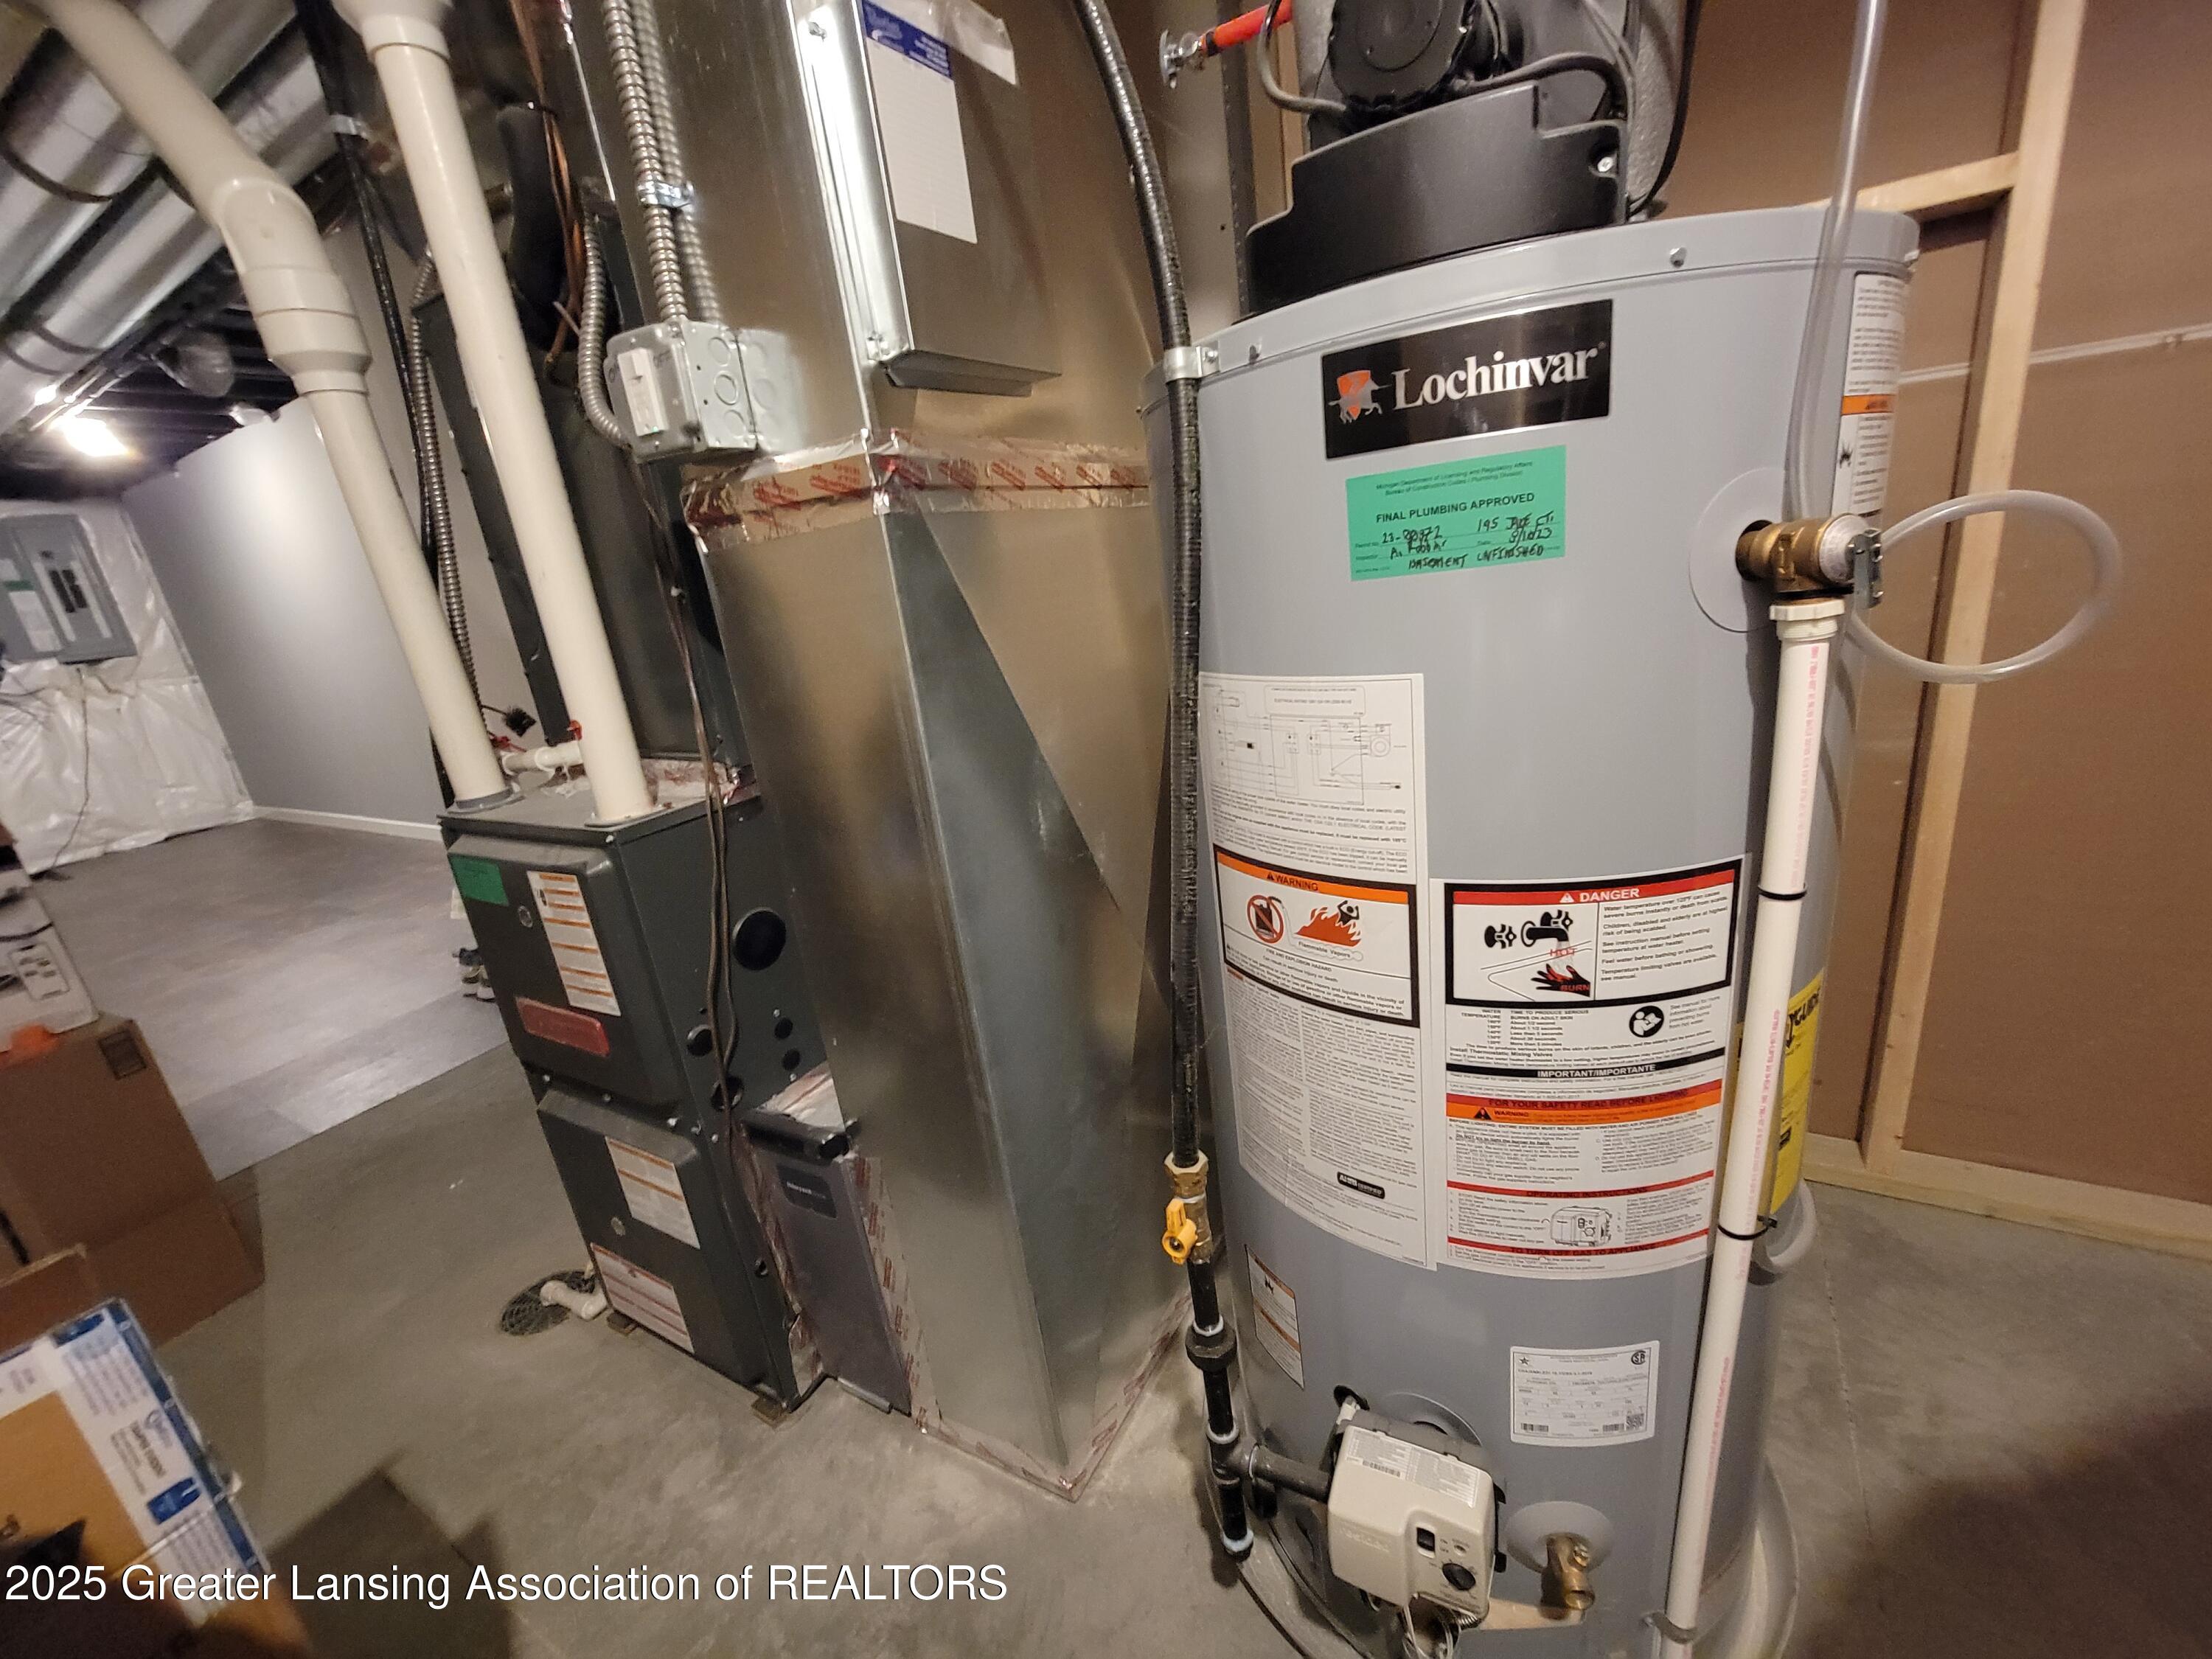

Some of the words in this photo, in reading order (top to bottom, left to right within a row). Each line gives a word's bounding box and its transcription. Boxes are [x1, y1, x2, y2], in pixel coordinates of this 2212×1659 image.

[1391, 348, 1599, 410] Lochinvar
[1376, 512, 1406, 523] FINAL
[1410, 502, 1467, 518] PLUMBING
[1470, 493, 1534, 509] APPROVED
[1478, 516, 1499, 532] 195
[1273, 874, 1319, 891] WARNING
[1579, 888, 1640, 902] DANGER
[1298, 942, 1327, 953] Flammable
[1330, 949, 1351, 959] Vapors
[1537, 1064, 1656, 1078] IMPORTANT/IMPORTANTE
[1512, 1100, 1539, 1108] YOUR
[1542, 1101, 1578, 1109] SAFETY
